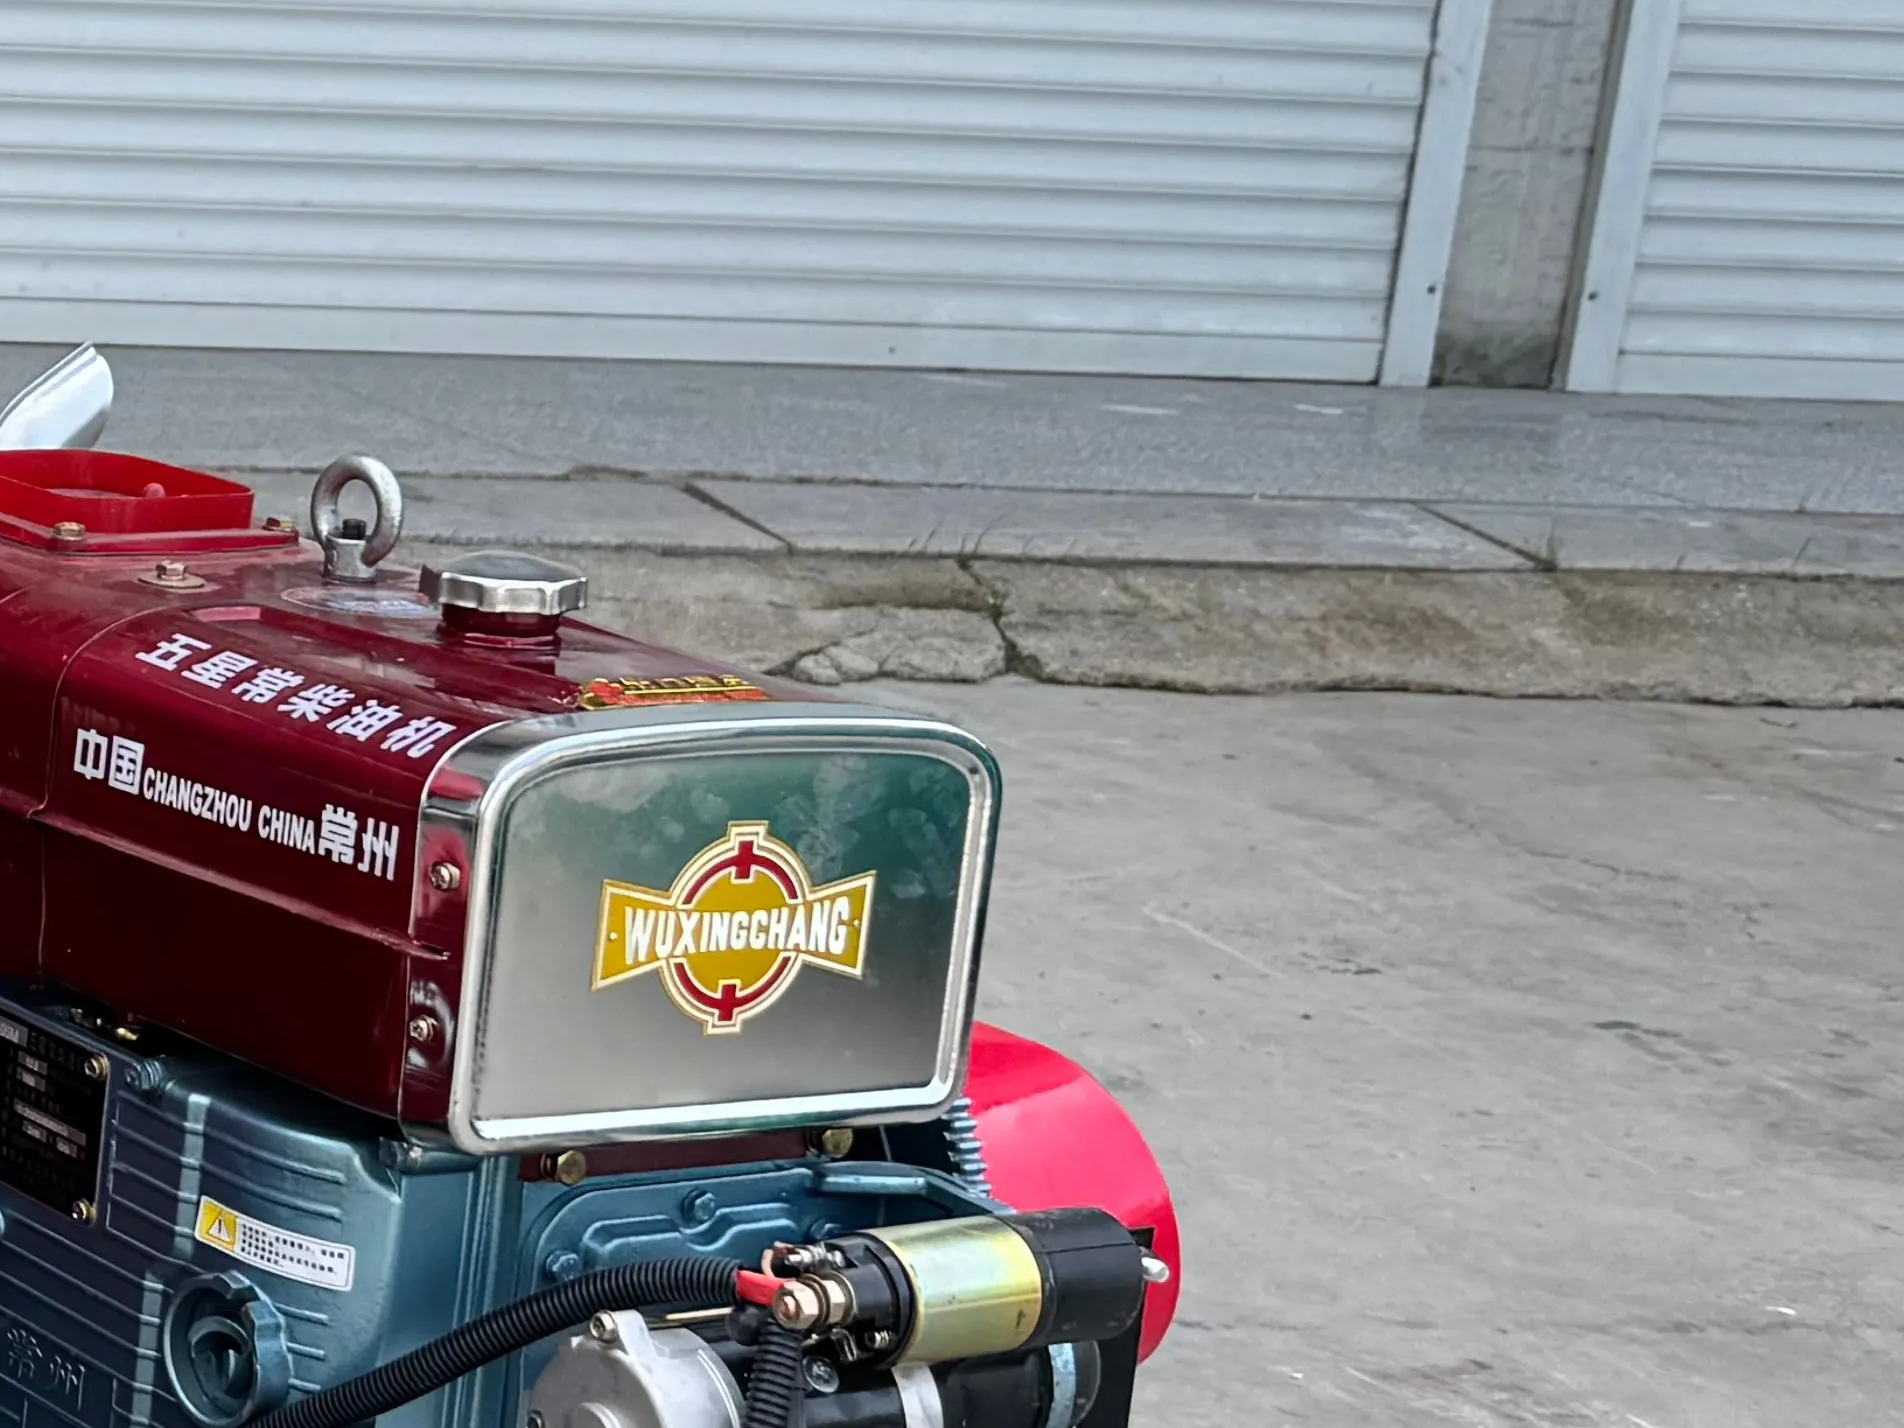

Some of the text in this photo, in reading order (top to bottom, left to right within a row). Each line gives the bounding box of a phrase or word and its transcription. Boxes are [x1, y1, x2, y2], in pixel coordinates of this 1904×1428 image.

[135, 632, 457, 759] 五星常柴油机
[73, 727, 401, 881] 中国 CHANGZHOU CHINA 常州
[624, 895, 851, 965] WUXINGCHANG
